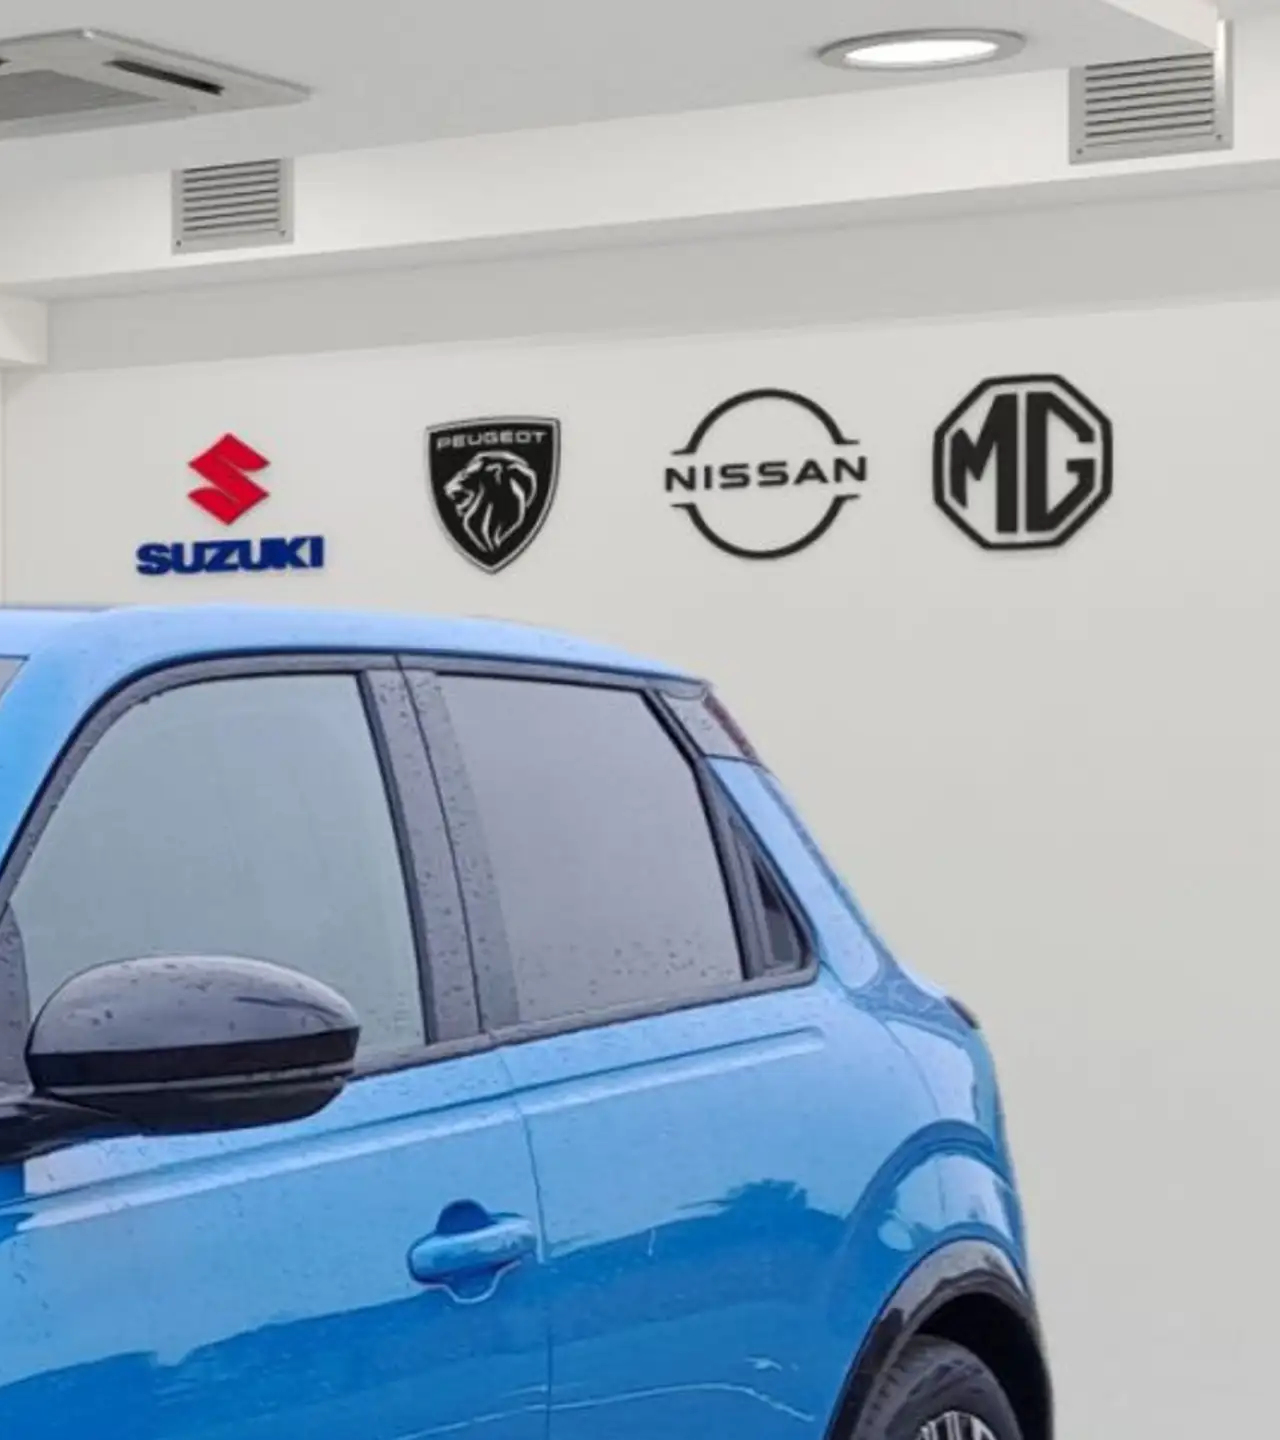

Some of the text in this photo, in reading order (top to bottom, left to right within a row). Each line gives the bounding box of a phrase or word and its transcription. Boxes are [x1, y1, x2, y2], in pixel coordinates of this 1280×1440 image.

[436, 429, 548, 450] PEUGEOT
[664, 456, 868, 492] NISSAN
[950, 391, 1095, 533] MG
[136, 535, 325, 575] SUZUKI
